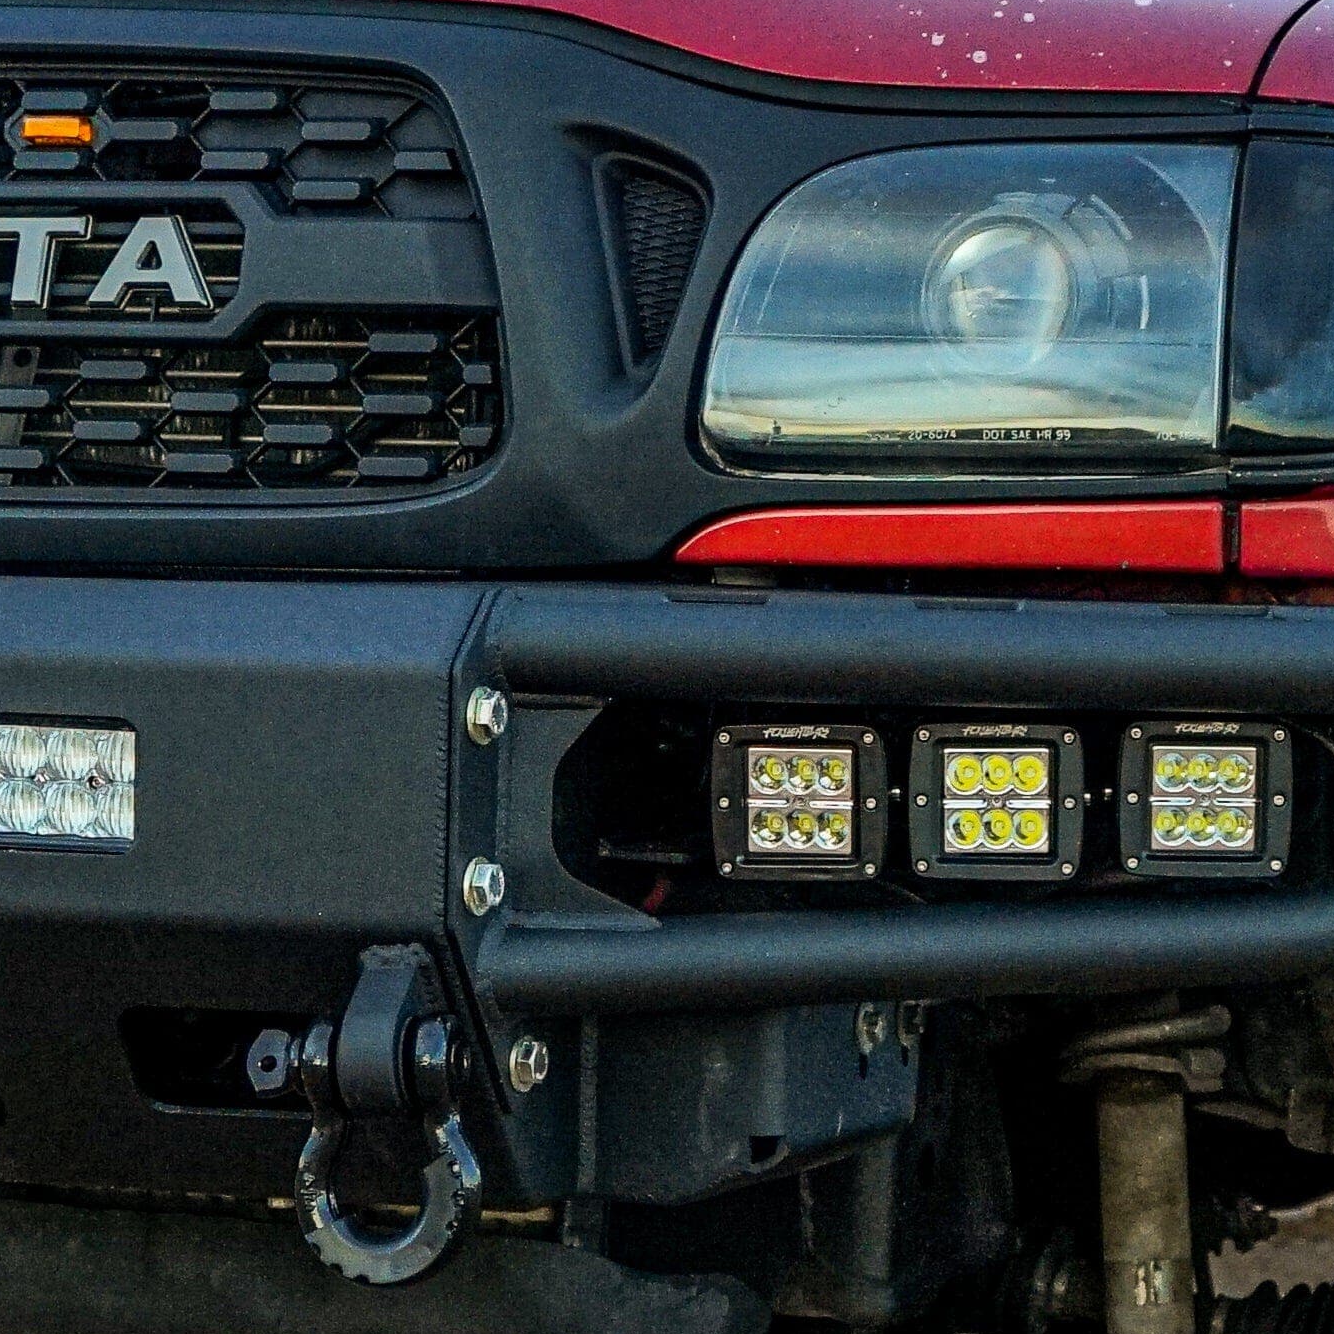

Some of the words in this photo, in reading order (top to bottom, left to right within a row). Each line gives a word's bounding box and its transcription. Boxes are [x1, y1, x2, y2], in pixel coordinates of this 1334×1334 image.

[982, 429, 1006, 440] DOT
[1011, 429, 1032, 440] SAE
[1036, 429, 1052, 440] HR
[1055, 429, 1071, 441] 99
